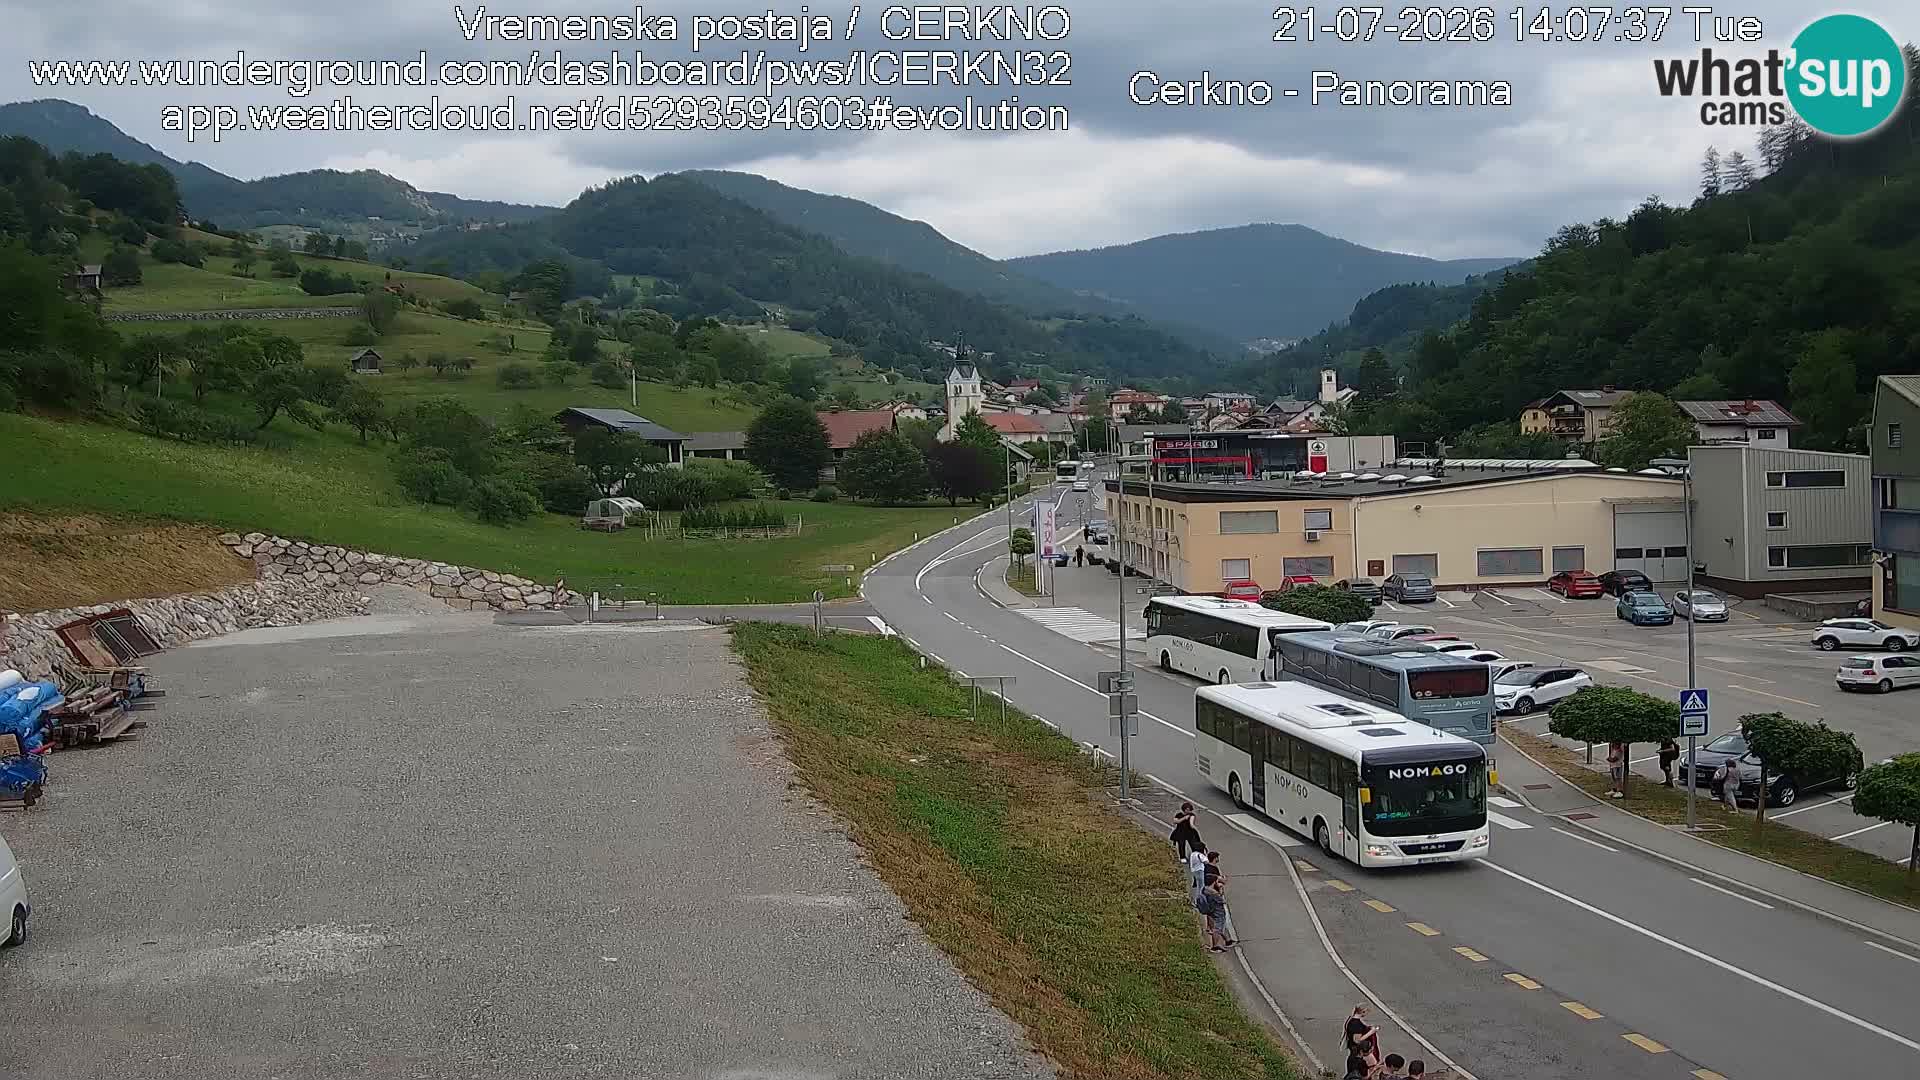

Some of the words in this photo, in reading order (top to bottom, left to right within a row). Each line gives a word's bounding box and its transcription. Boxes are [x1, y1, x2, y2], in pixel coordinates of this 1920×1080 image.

[1166, 440, 1202, 449] SPAR
[1388, 764, 1467, 780] NOMAGO
[1420, 843, 1446, 851] MAN
